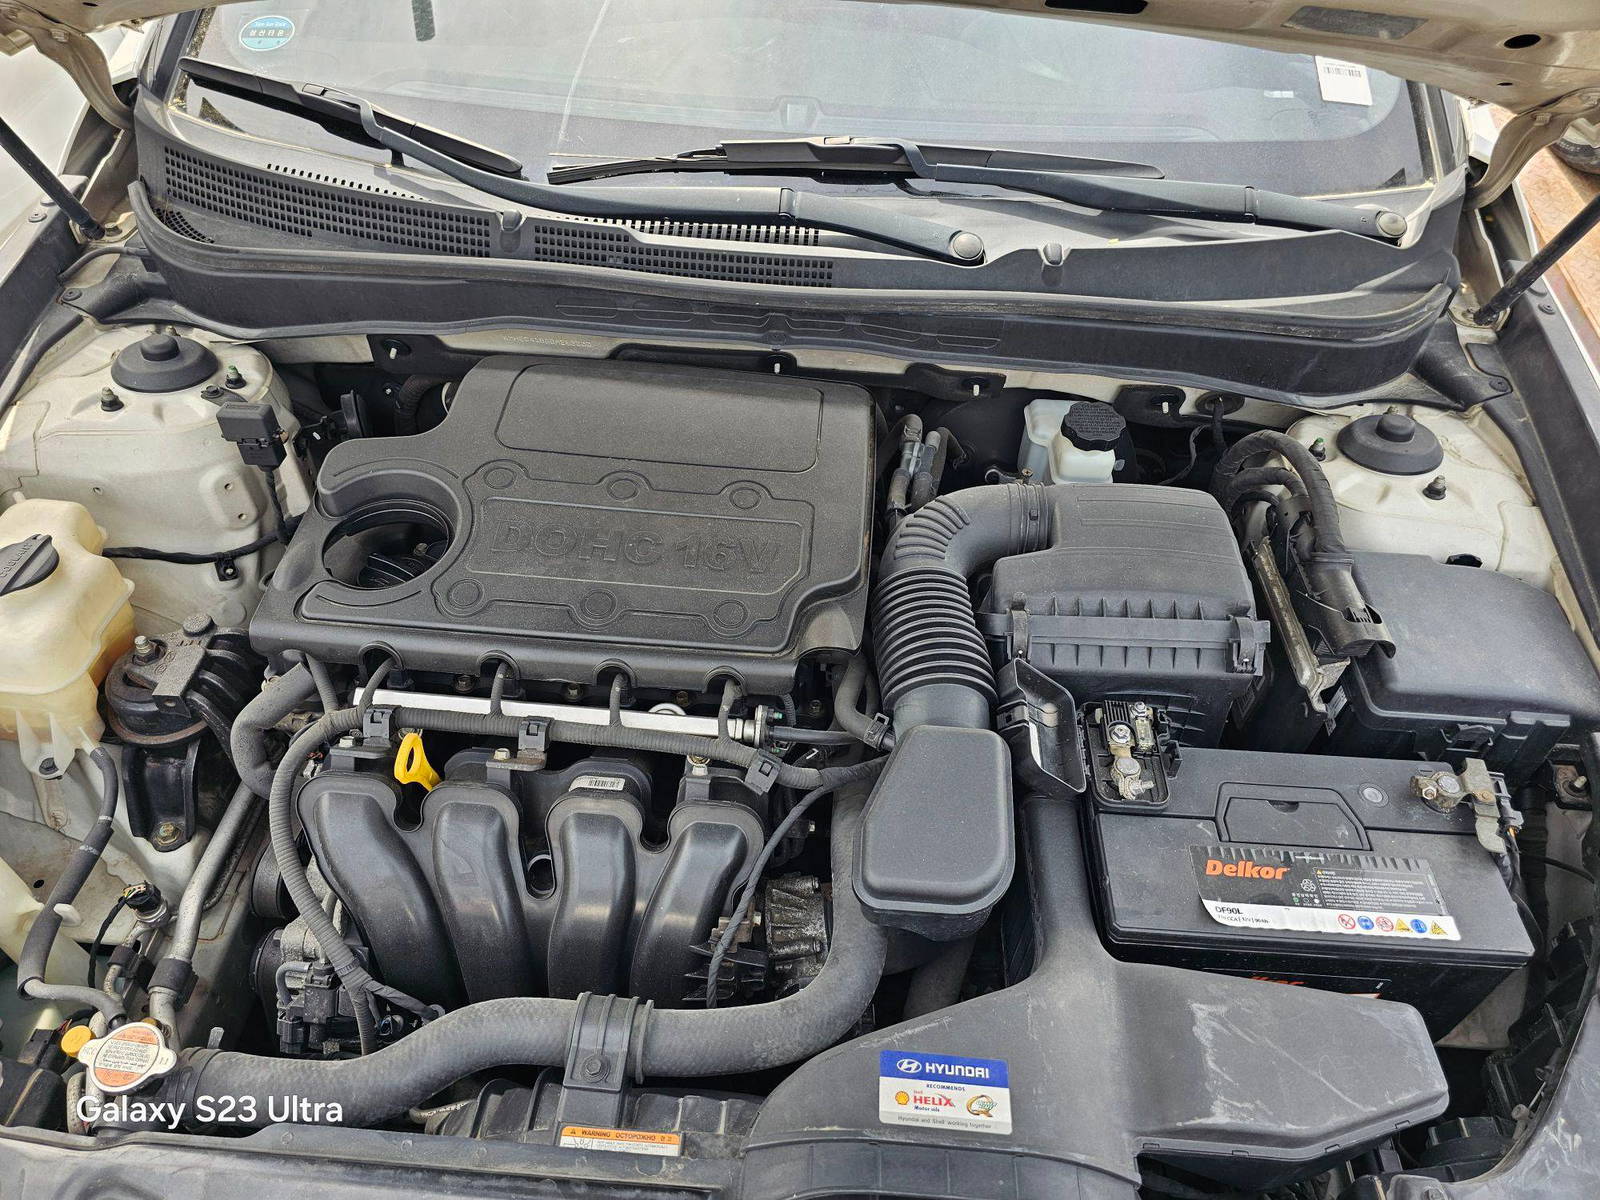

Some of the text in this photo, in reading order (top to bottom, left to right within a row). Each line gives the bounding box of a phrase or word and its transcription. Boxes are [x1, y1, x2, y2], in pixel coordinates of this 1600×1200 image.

[491, 520, 777, 573] DOHC 16V
[1205, 859, 1287, 880] Delkor
[1215, 905, 1243, 915] DF90L
[926, 1062, 989, 1078] HYUNDAI
[926, 1083, 966, 1092] RECOMMENDS
[913, 1094, 955, 1108] HELIX
[897, 1115, 919, 1124] Hyundai
[947, 1120, 968, 1129] working
[970, 1121, 992, 1130] together
[581, 1129, 611, 1138] WARNING
